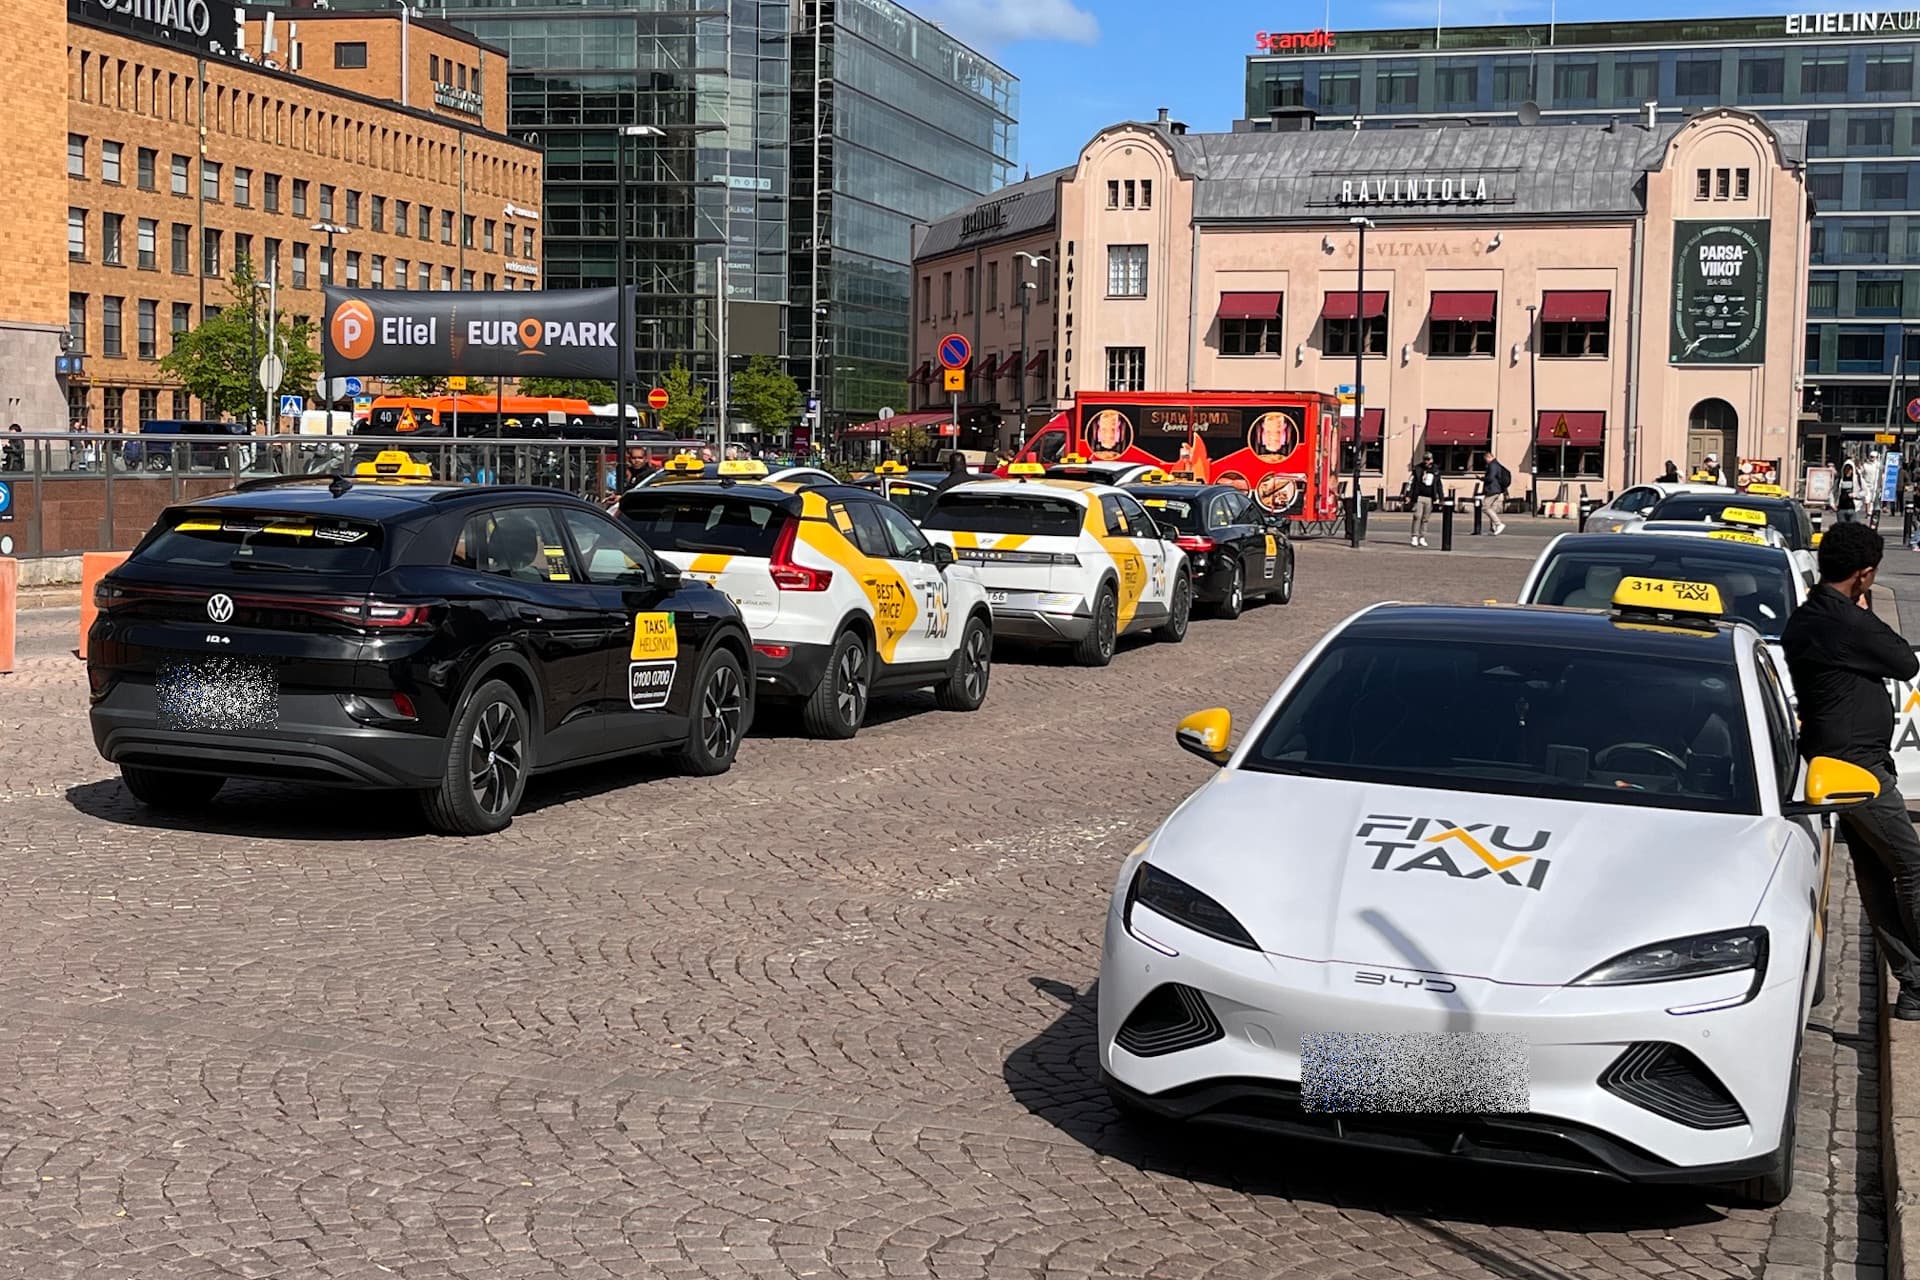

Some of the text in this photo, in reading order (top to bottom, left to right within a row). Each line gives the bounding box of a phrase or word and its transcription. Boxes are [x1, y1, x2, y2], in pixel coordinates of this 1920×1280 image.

[1785, 11, 1920, 34] ELIELINAU
[1255, 27, 1336, 49] Scandic
[1342, 178, 1487, 203] RAVINTOLA
[1376, 242, 1449, 257] VLTAVA
[1699, 245, 1748, 261] PARSA-
[1700, 261, 1743, 277] VIIKOT
[1063, 240, 1075, 399] RAVINTOLA
[382, 316, 437, 345] Eliel
[467, 318, 618, 348] EUROPARK
[380, 411, 392, 422] 40
[1632, 581, 1708, 592] 314 FIXU
[1676, 590, 1709, 601] TAXI
[644, 619, 667, 634] TAKSI
[640, 635, 674, 652] HELSINKI
[633, 670, 670, 687] 0100 0700
[1356, 814, 1551, 851] FIXU
[1365, 841, 1550, 891] TAXI
[1354, 971, 1456, 993] BYD
